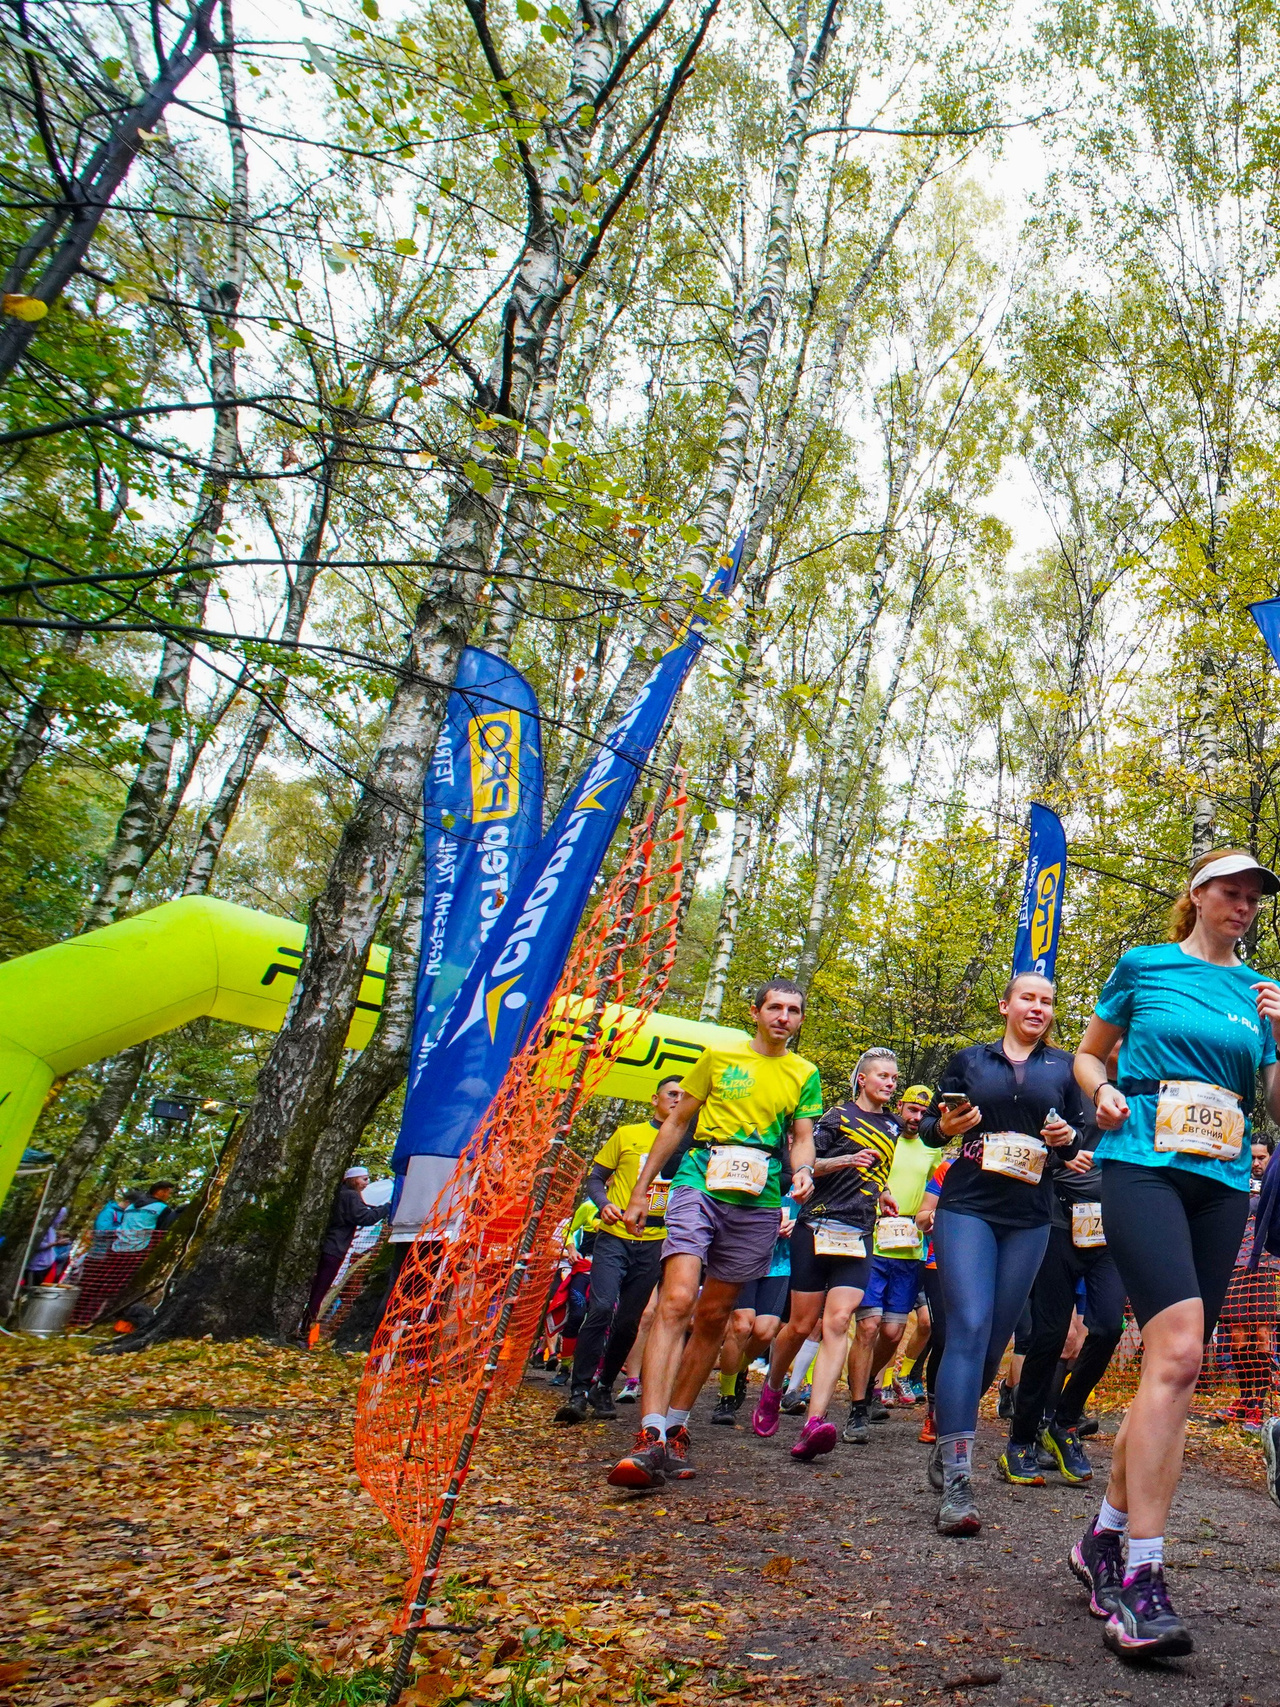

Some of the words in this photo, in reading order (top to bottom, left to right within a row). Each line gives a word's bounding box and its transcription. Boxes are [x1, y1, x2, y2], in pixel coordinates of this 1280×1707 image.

[1186, 1105, 1223, 1128] 105
[1182, 1124, 1223, 1140] Евгения
[1004, 1146, 1031, 1161] 132
[731, 1160, 750, 1172] 59
